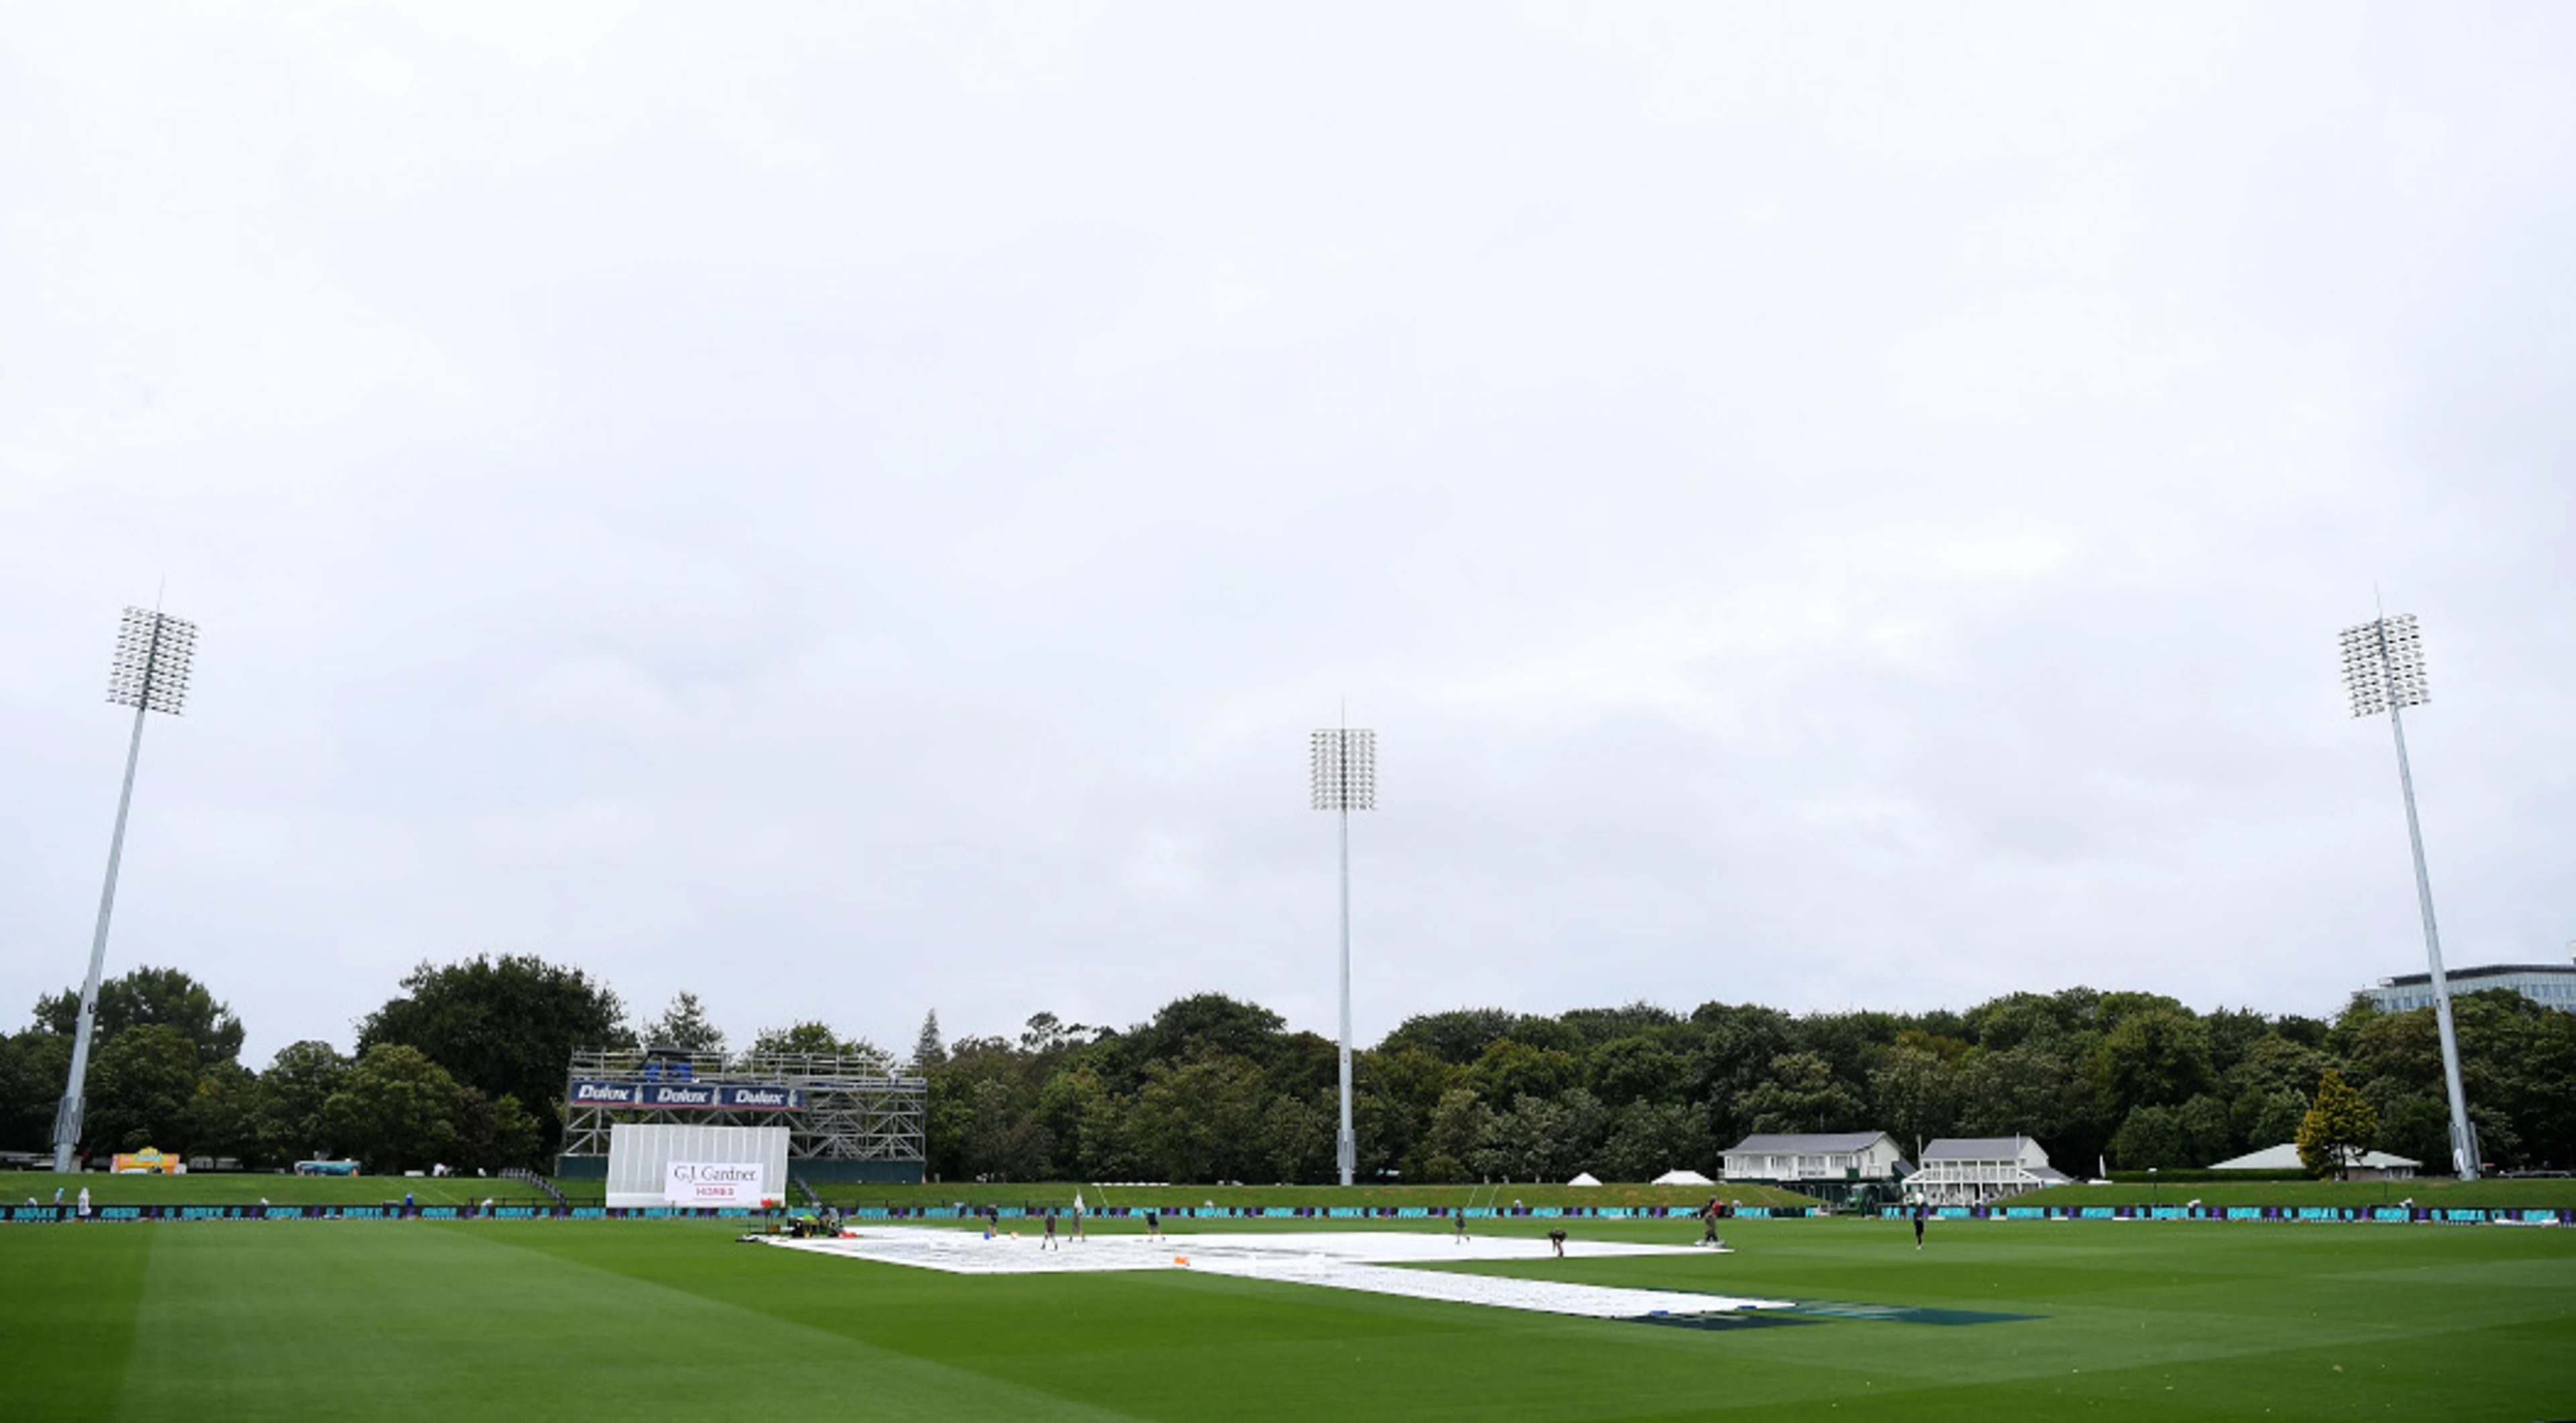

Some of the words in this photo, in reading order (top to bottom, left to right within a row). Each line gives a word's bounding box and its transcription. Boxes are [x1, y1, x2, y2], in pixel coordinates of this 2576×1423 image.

[579, 1085, 629, 1100] Dulux
[657, 1088, 708, 1102] Dulux
[735, 1090, 784, 1104] Dulux
